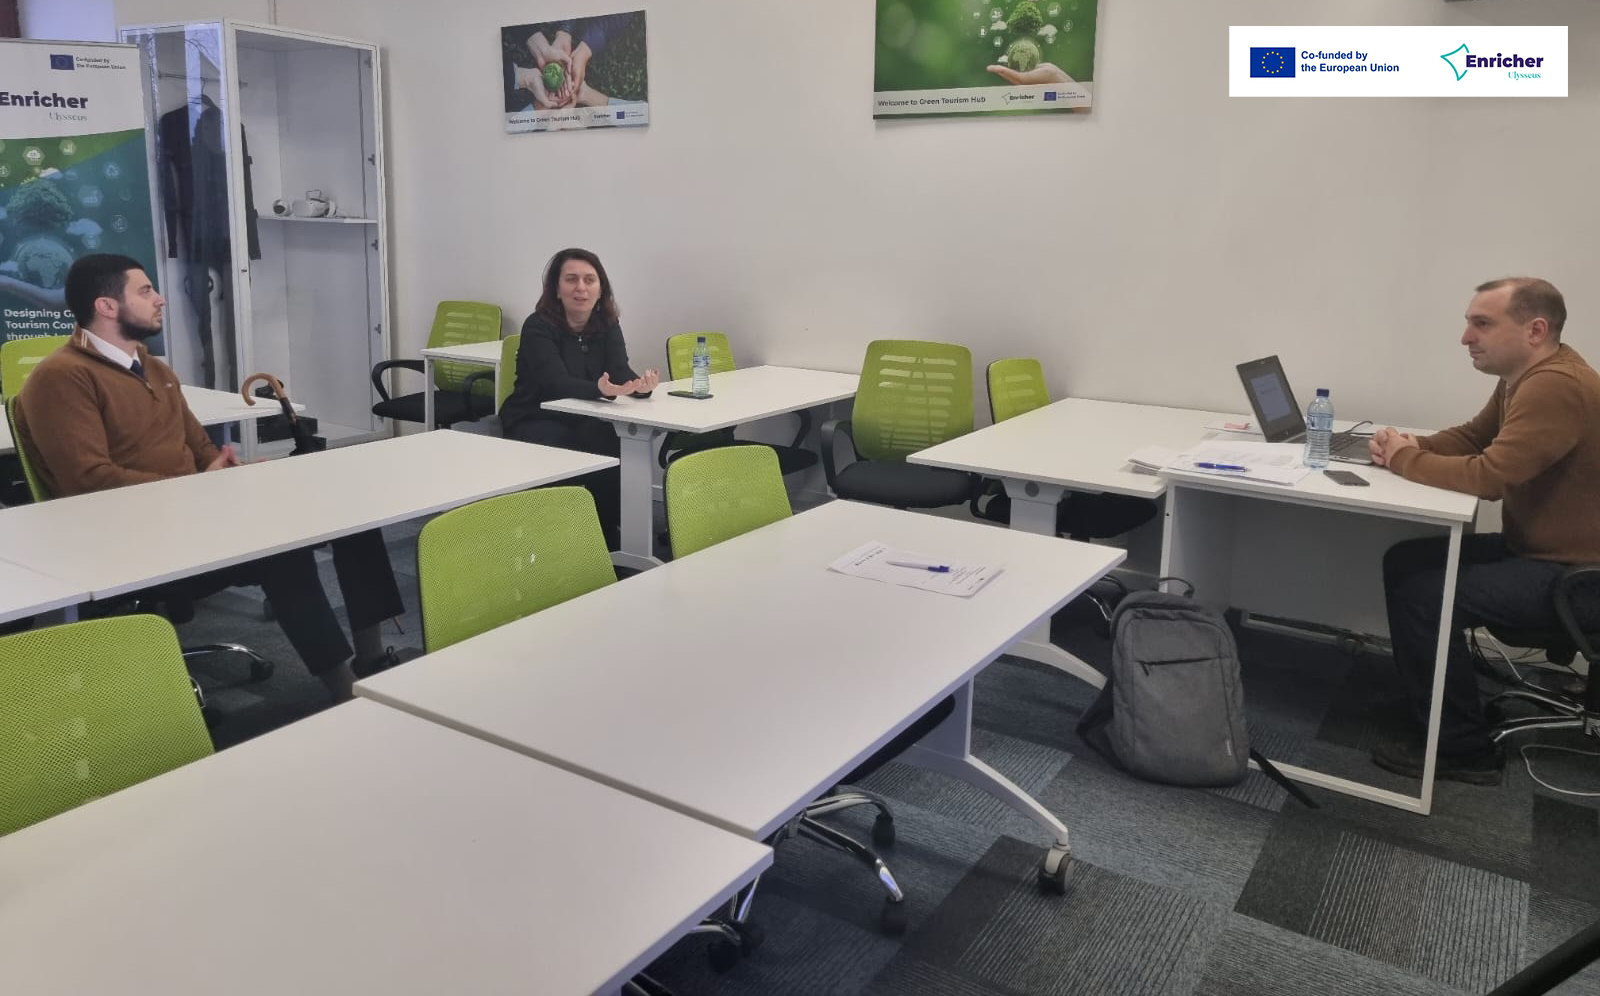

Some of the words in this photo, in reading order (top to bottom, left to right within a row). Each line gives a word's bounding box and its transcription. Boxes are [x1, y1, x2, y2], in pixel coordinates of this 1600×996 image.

[0, 90, 89, 109] Enricher
[4, 308, 61, 319] Designing
[5, 320, 50, 329] Tourism
[52, 321, 75, 329] Con
